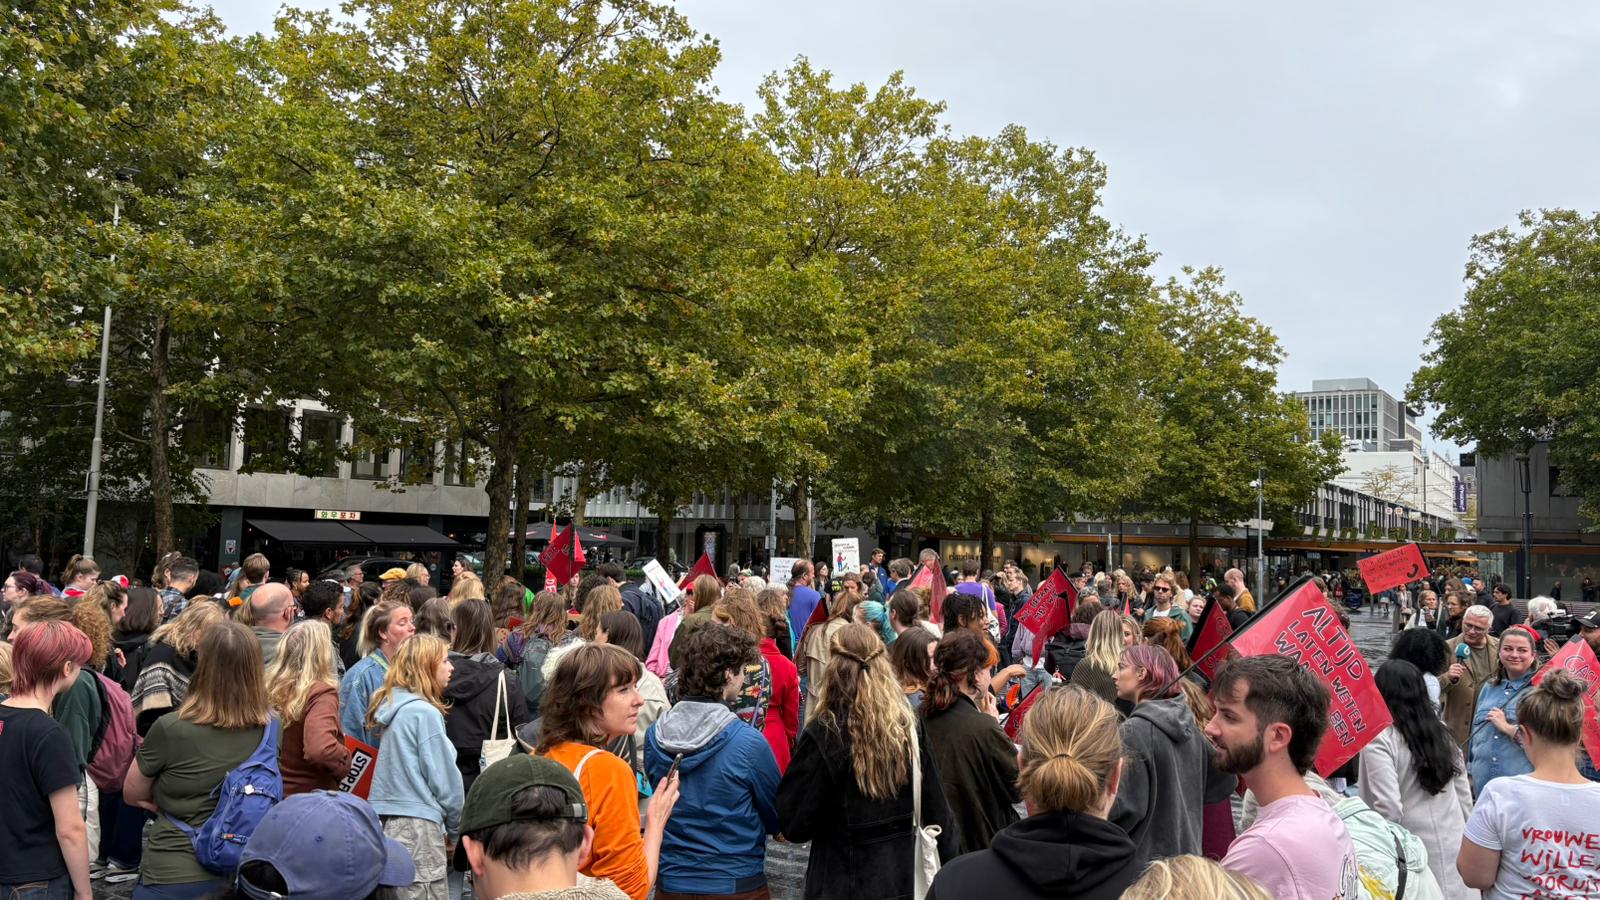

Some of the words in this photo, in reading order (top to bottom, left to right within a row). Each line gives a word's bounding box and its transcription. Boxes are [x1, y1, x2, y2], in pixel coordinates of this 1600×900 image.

[1288, 620, 1333, 676] LATEN
[1331, 677, 1366, 733] WETEN
[1302, 605, 1364, 680] ALTIJD
[346, 755, 368, 785] STOP
